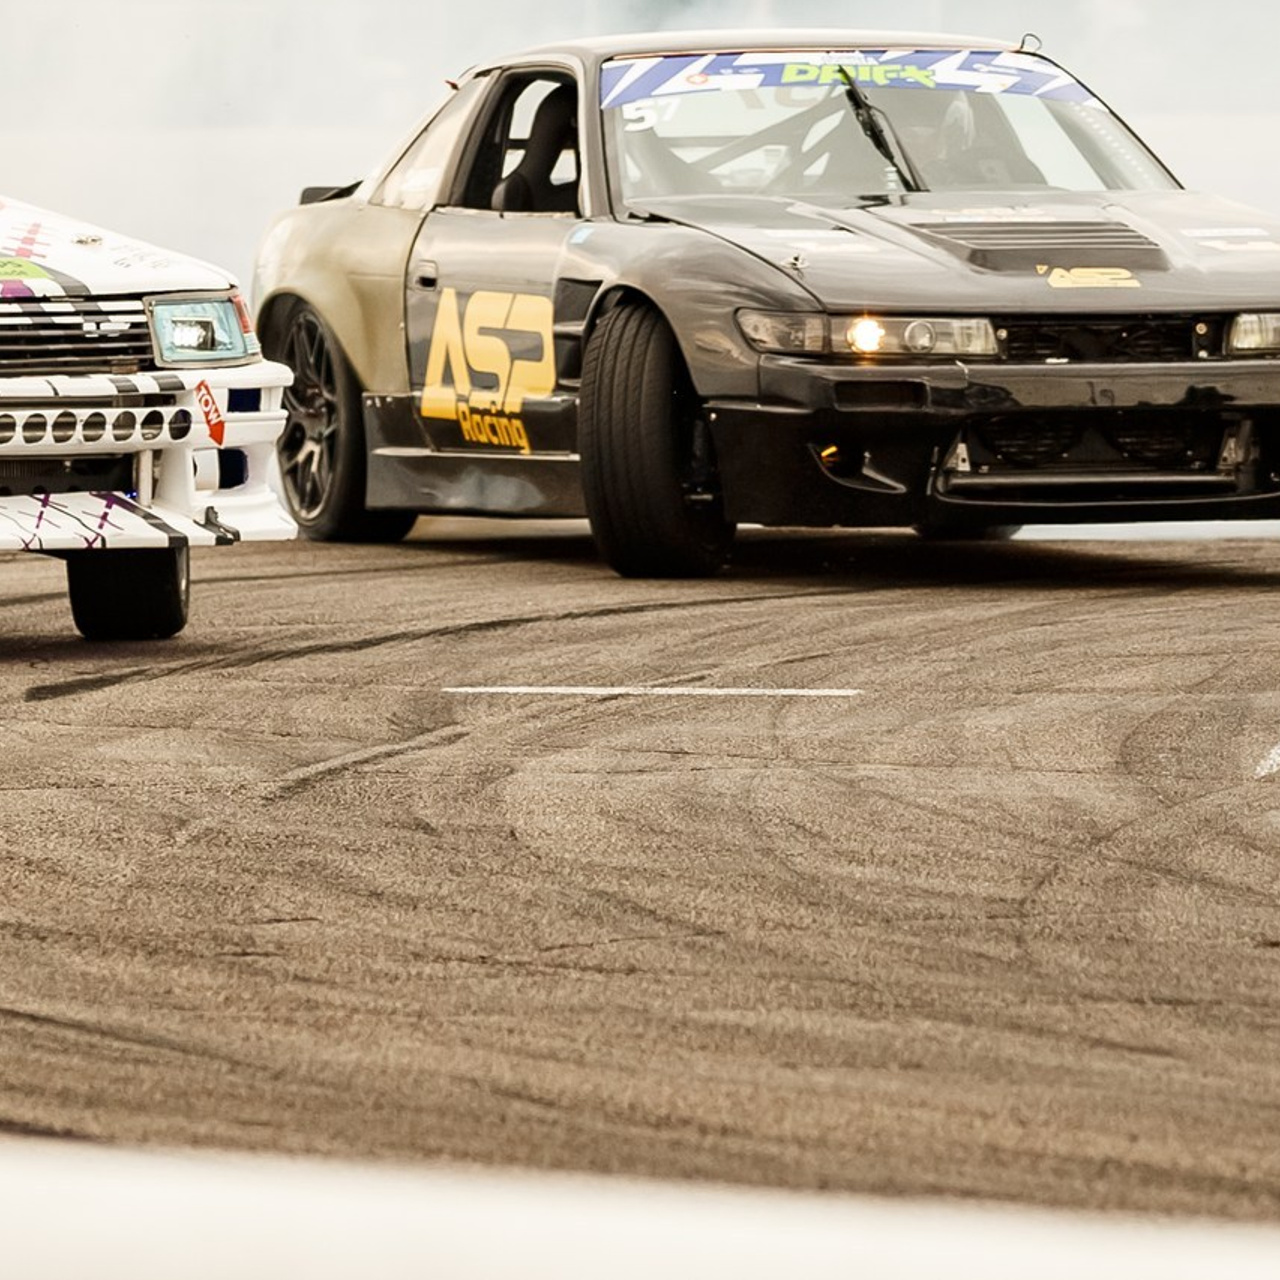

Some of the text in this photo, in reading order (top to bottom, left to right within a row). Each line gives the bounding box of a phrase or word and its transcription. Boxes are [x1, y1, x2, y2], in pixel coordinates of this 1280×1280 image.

[622, 98, 681, 131] 57
[421, 287, 556, 417] ASP
[197, 385, 224, 426] TOW
[457, 400, 531, 455] Racing
